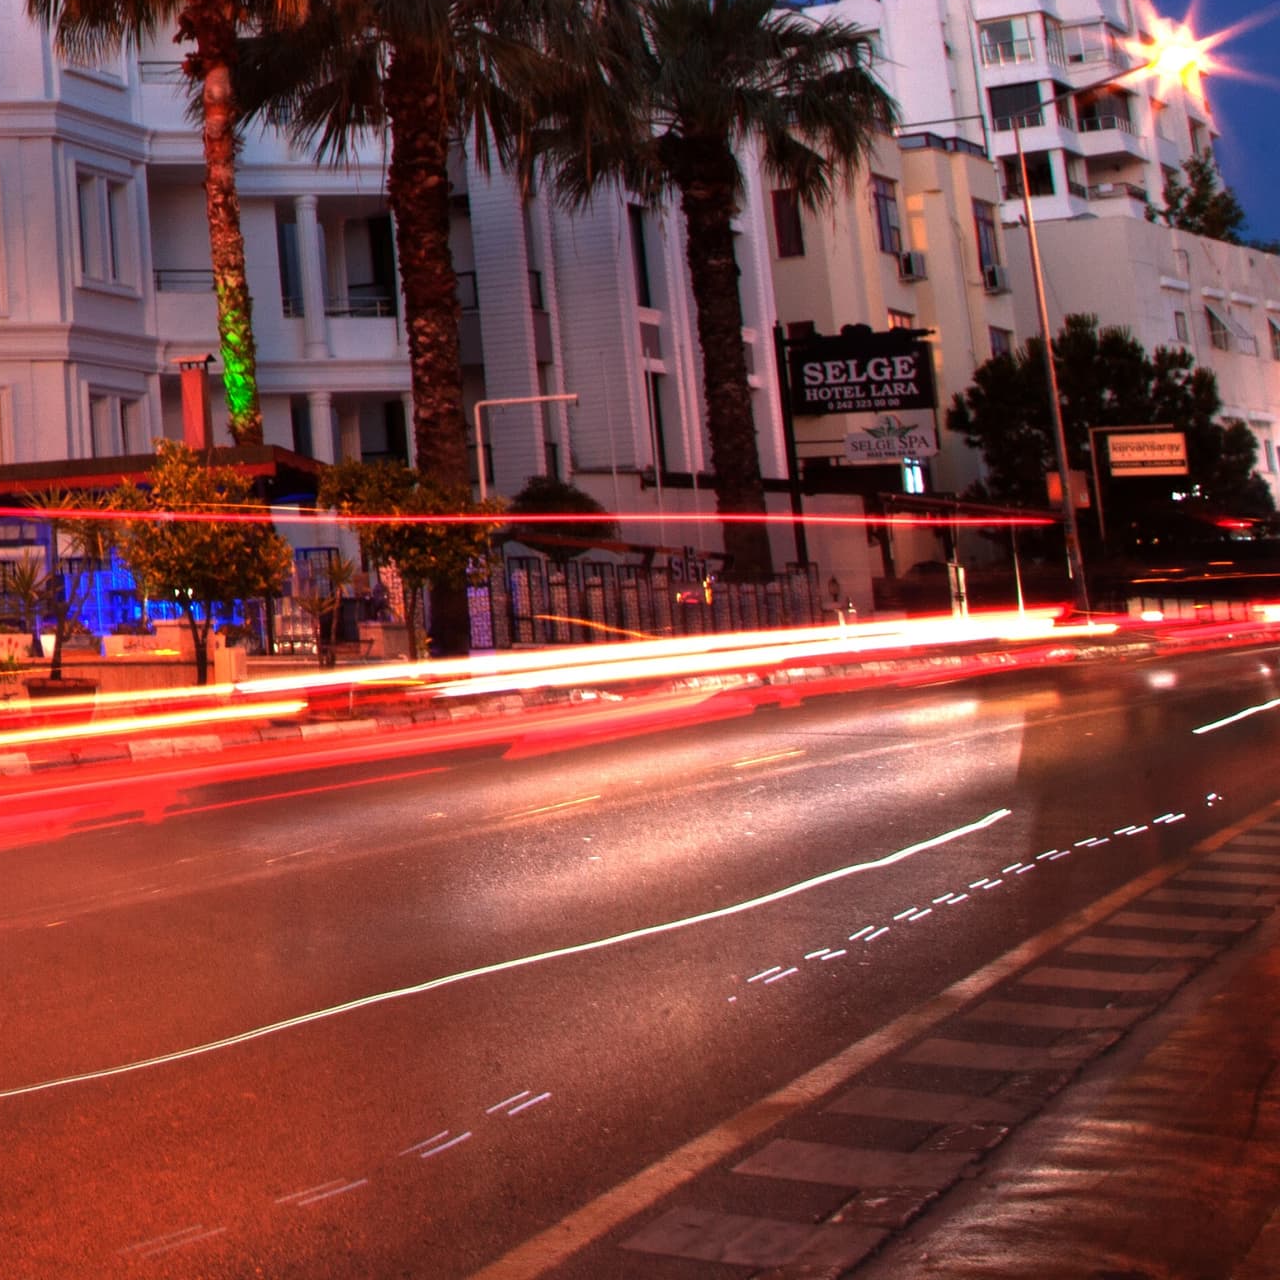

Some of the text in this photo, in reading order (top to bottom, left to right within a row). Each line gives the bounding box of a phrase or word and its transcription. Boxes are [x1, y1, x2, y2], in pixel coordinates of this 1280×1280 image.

[802, 355, 917, 386] SELGE
[805, 382, 919, 402] HOTEL LARA
[851, 435, 929, 452] SELGE SPA
